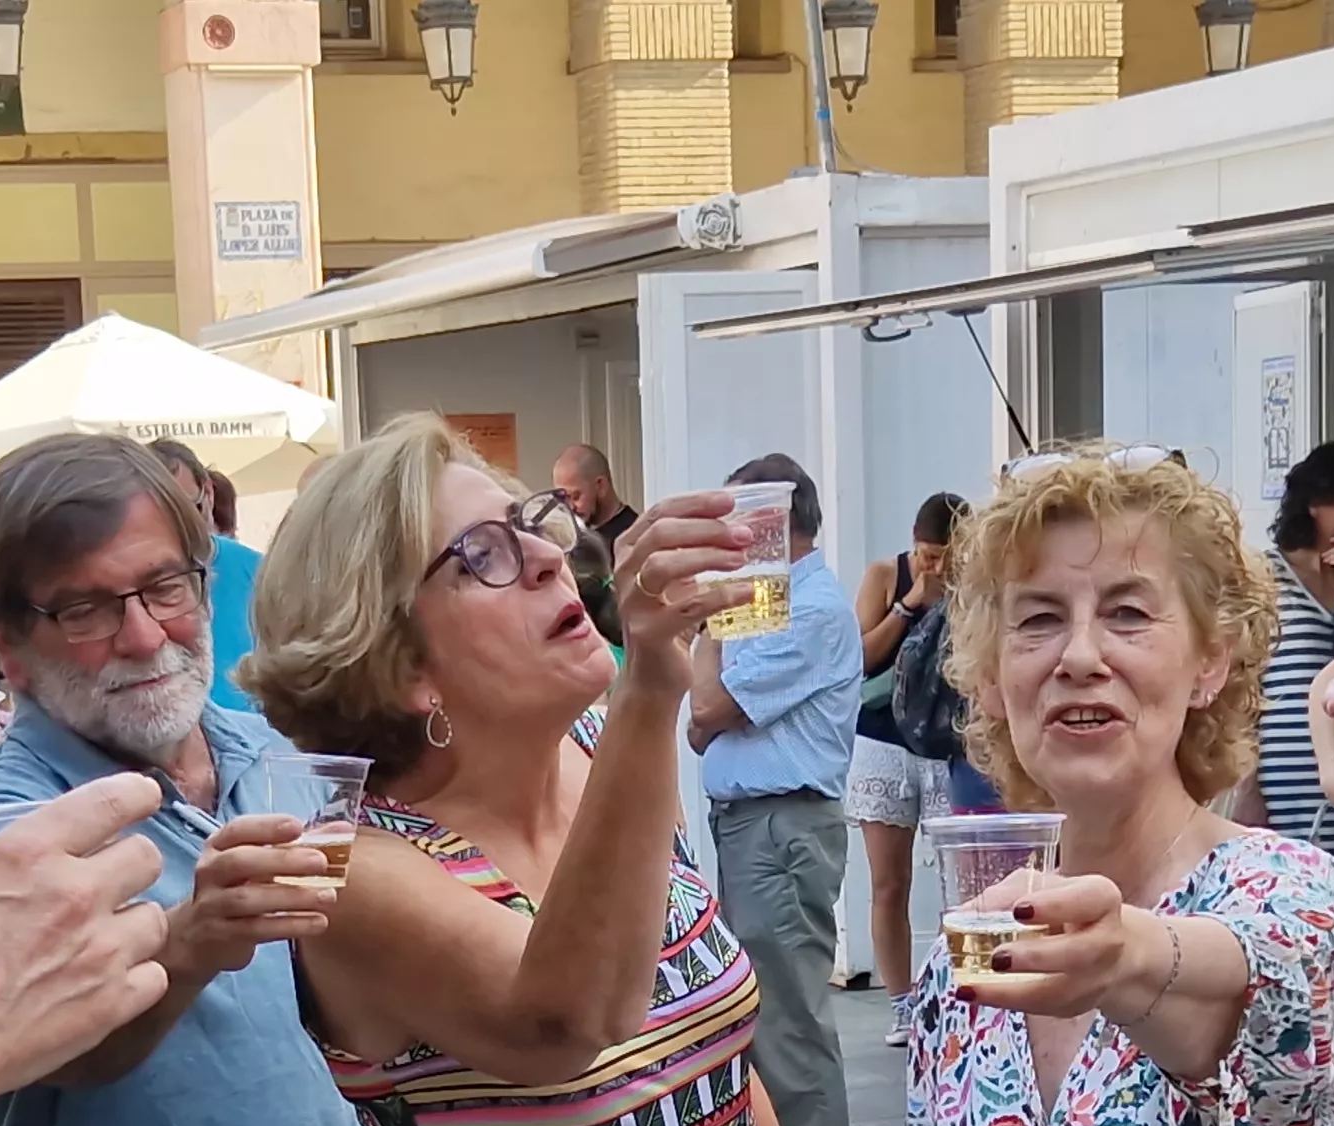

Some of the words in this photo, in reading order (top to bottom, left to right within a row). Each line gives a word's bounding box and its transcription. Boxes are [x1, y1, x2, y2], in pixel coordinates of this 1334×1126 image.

[240, 208, 279, 222] PLAZA
[258, 223, 290, 237] LUIS
[135, 420, 205, 439] ESTRELLA
[209, 420, 254, 436] DAMM
